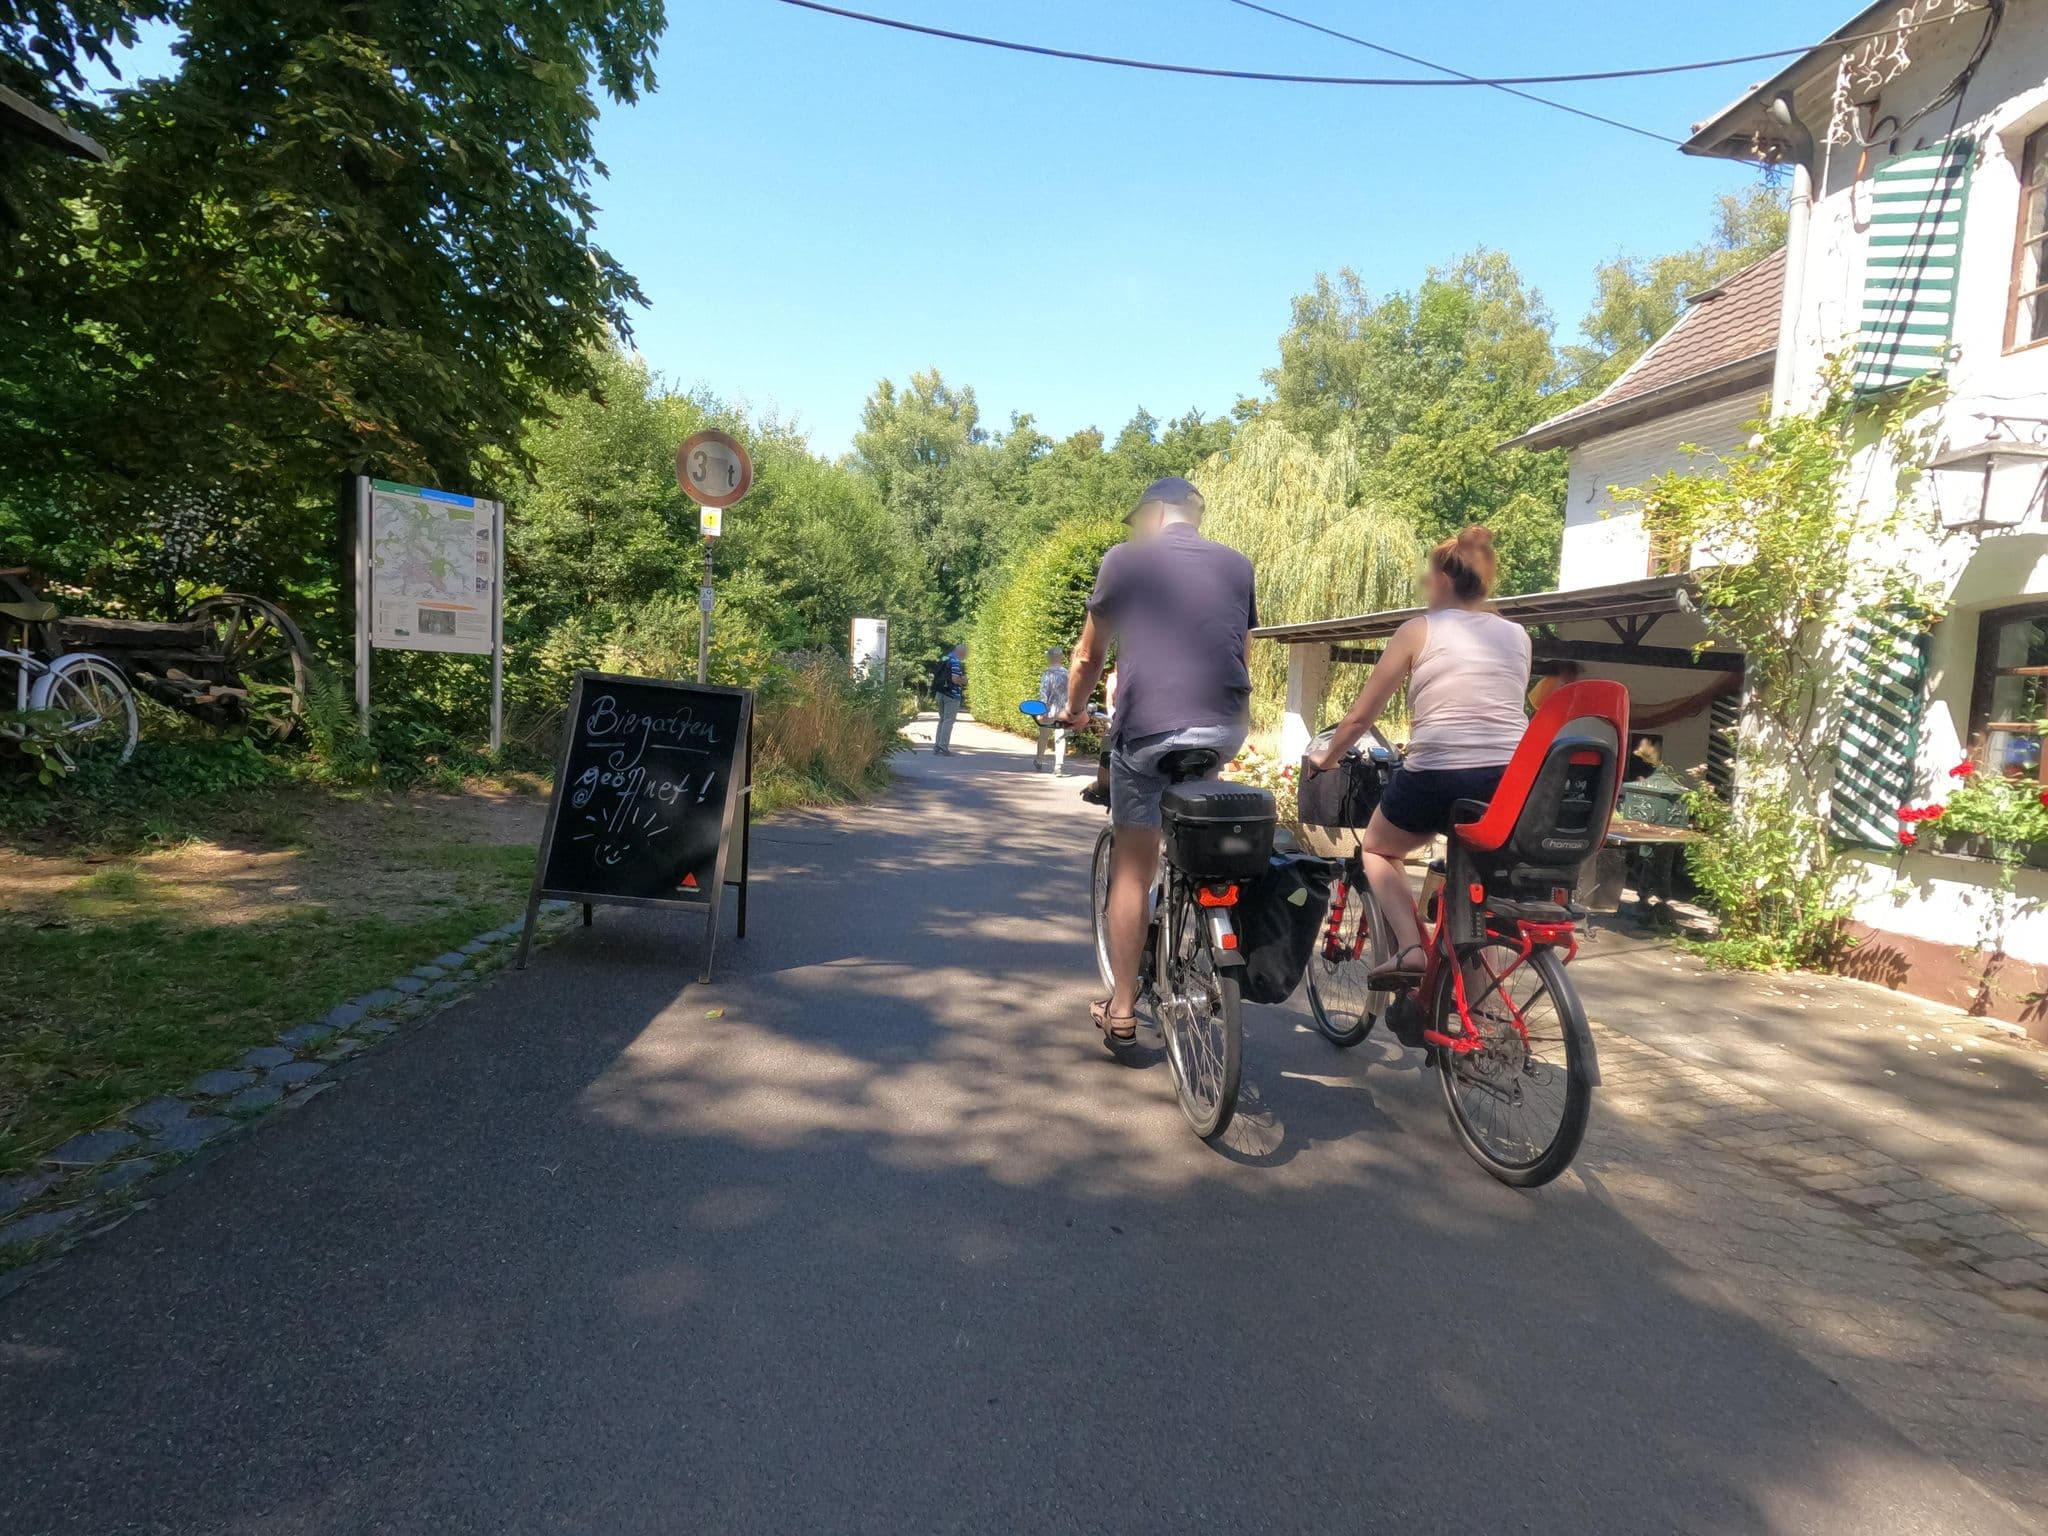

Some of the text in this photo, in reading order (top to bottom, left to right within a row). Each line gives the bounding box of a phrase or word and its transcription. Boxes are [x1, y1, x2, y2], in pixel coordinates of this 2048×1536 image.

[693, 450, 735, 488] 3 t
[587, 695, 720, 771] Biergarten
